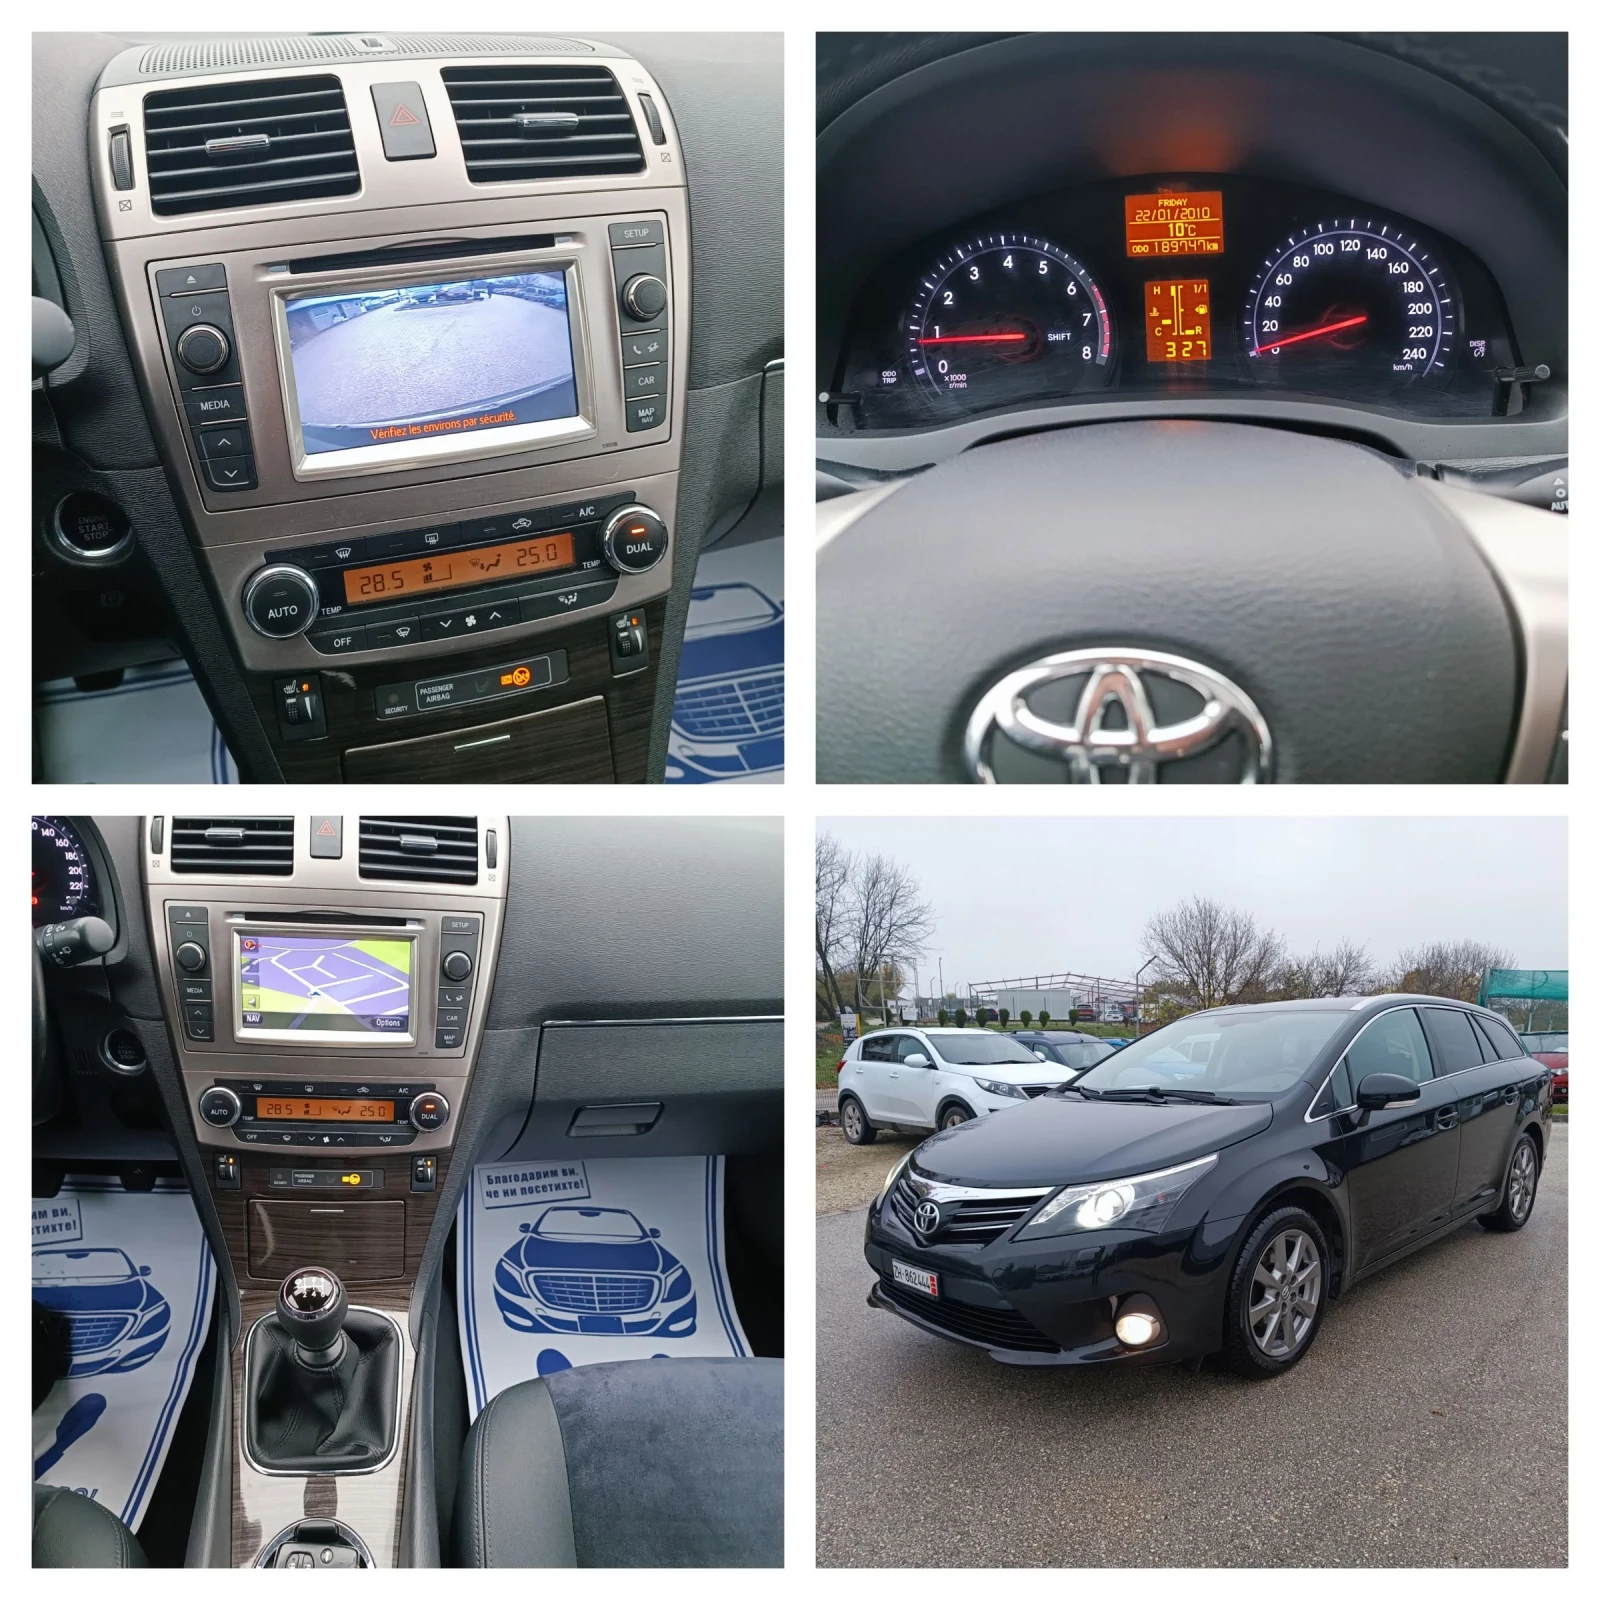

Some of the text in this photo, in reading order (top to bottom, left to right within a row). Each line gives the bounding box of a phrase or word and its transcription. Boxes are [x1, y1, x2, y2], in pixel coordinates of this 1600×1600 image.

[1158, 198, 1188, 207] FRIDAY
[1135, 207, 1211, 222] 22/01/2010
[624, 228, 649, 239] SETUP
[1132, 245, 1149, 253] ODO
[1313, 243, 1334, 256] 100
[1339, 239, 1361, 251] 120
[1366, 248, 1388, 260] 140
[1003, 255, 1014, 268] 4
[1039, 261, 1048, 274] 5
[1293, 255, 1310, 268] 80
[970, 266, 979, 280] 3
[1388, 262, 1409, 274] 160
[1275, 273, 1292, 286] 60
[1067, 281, 1076, 295] 6
[1153, 286, 1161, 295] H
[1193, 284, 1207, 294] 1/1
[1402, 281, 1424, 293] 180
[943, 292, 953, 305] 2
[1264, 296, 1282, 308] 40
[1408, 303, 1432, 315] 200
[1082, 313, 1092, 326] 7
[1155, 327, 1162, 336] C
[1195, 326, 1202, 335] R
[1262, 320, 1279, 332] 20
[1409, 326, 1433, 338] 220
[934, 326, 940, 339] 1
[1047, 333, 1071, 341] SHIFT
[1165, 340, 1207, 358] 327
[1469, 340, 1486, 348] DISP.
[1082, 346, 1092, 360] 8
[1402, 348, 1427, 360] 240
[938, 360, 948, 374] 0
[1393, 363, 1413, 371] km/h
[638, 375, 655, 386] CAR
[200, 399, 230, 411] MEDIA
[638, 407, 655, 418] MAP
[370, 410, 517, 440] Vérifiez les environs par sécurité.
[641, 416, 654, 424] NAV
[578, 506, 595, 517] A/C
[78, 523, 109, 534] START
[83, 531, 109, 541] STOP
[626, 542, 653, 554] DUAL
[517, 543, 557, 567] 25.0
[582, 559, 601, 570] TEMP
[360, 570, 404, 595] 28.5
[268, 605, 298, 619] AUTO
[321, 606, 342, 616] TEMP
[333, 637, 352, 648] OFF
[420, 683, 454, 696] PASSENGER
[426, 692, 450, 704] AIRBAG
[385, 705, 409, 715] SECURITY
[41, 828, 55, 837] 140
[55, 839, 69, 847] 160
[65, 852, 79, 860] 180
[452, 921, 469, 929] SETUP
[246, 1014, 260, 1023] NAV
[376, 1018, 400, 1028] Options
[210, 1108, 228, 1116] AUTO
[486, 1168, 559, 1185] Благодарим
[485, 1178, 584, 1199] че ни посетихте!
